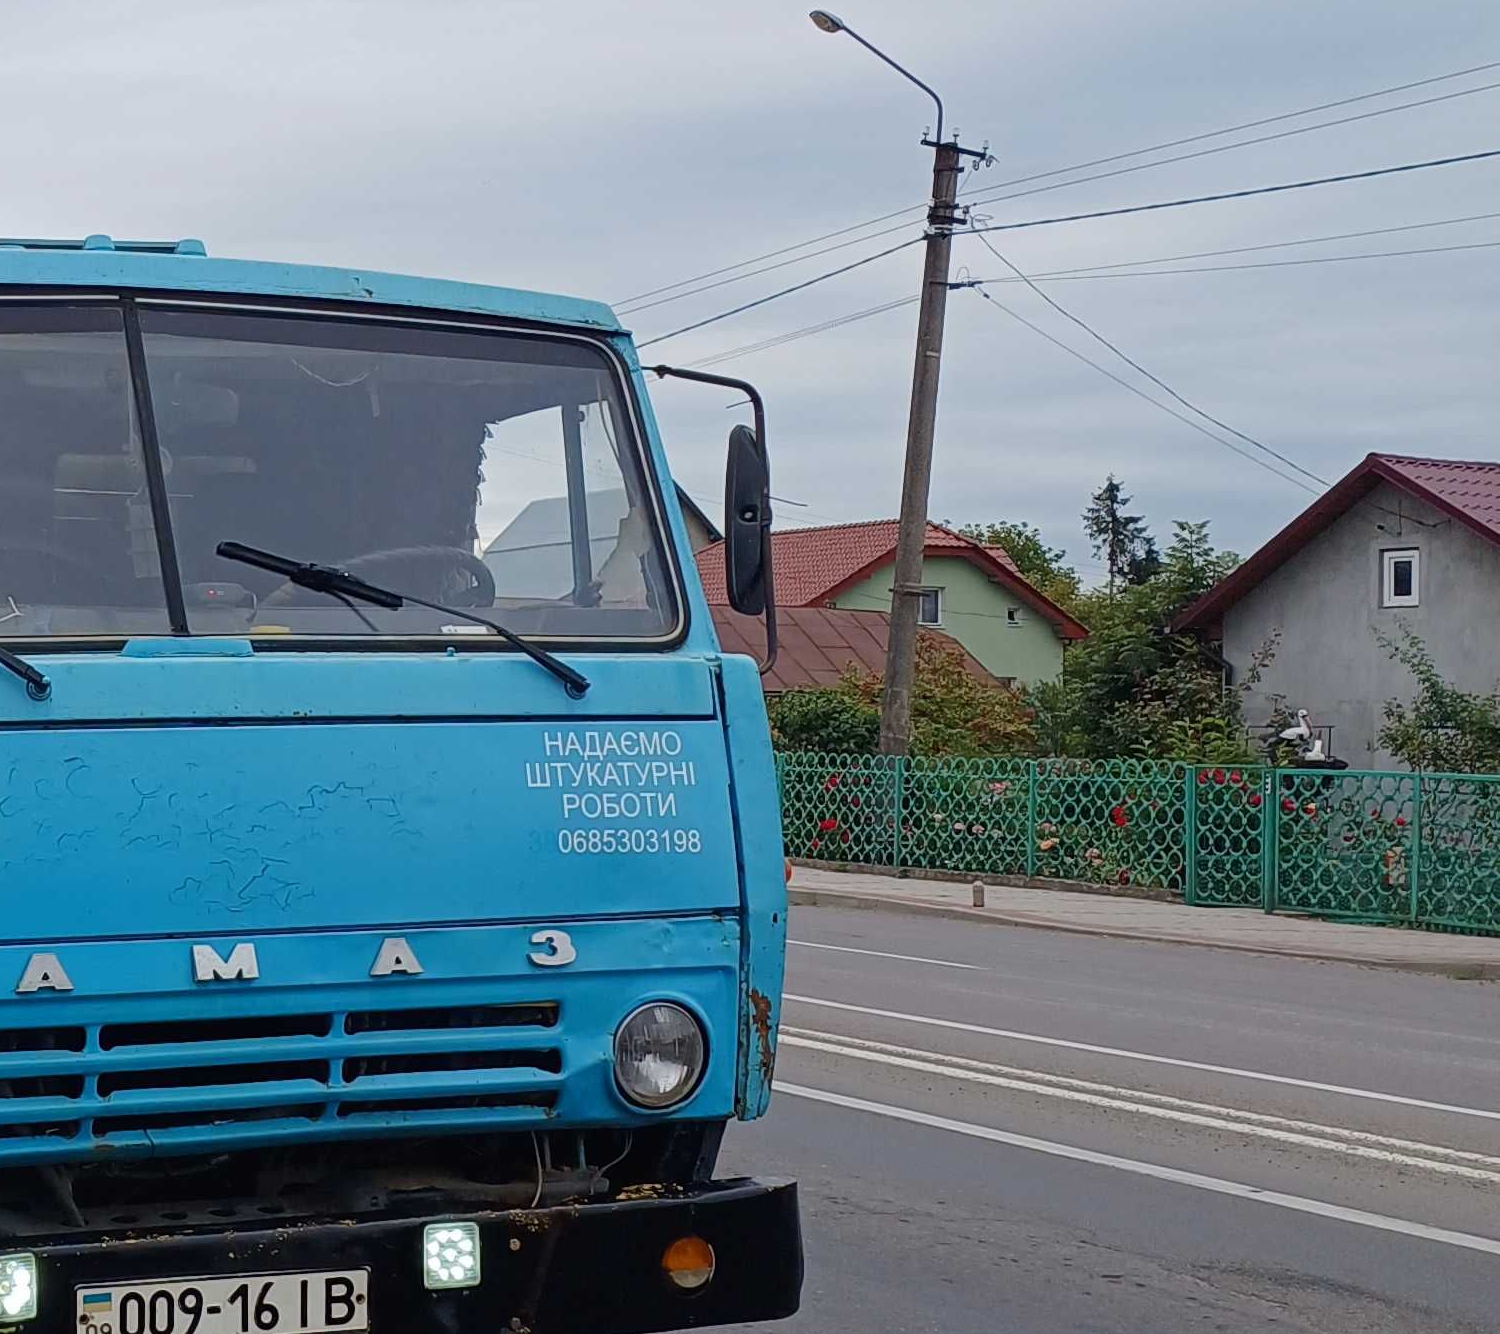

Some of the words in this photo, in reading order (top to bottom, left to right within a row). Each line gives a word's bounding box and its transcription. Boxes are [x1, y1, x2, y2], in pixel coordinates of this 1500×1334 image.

[543, 731, 682, 761] НАДАЄМО
[525, 761, 697, 788] ШТУКАТУРНІ
[562, 792, 677, 818] РОБОТИ
[558, 829, 702, 854] 0685303198
